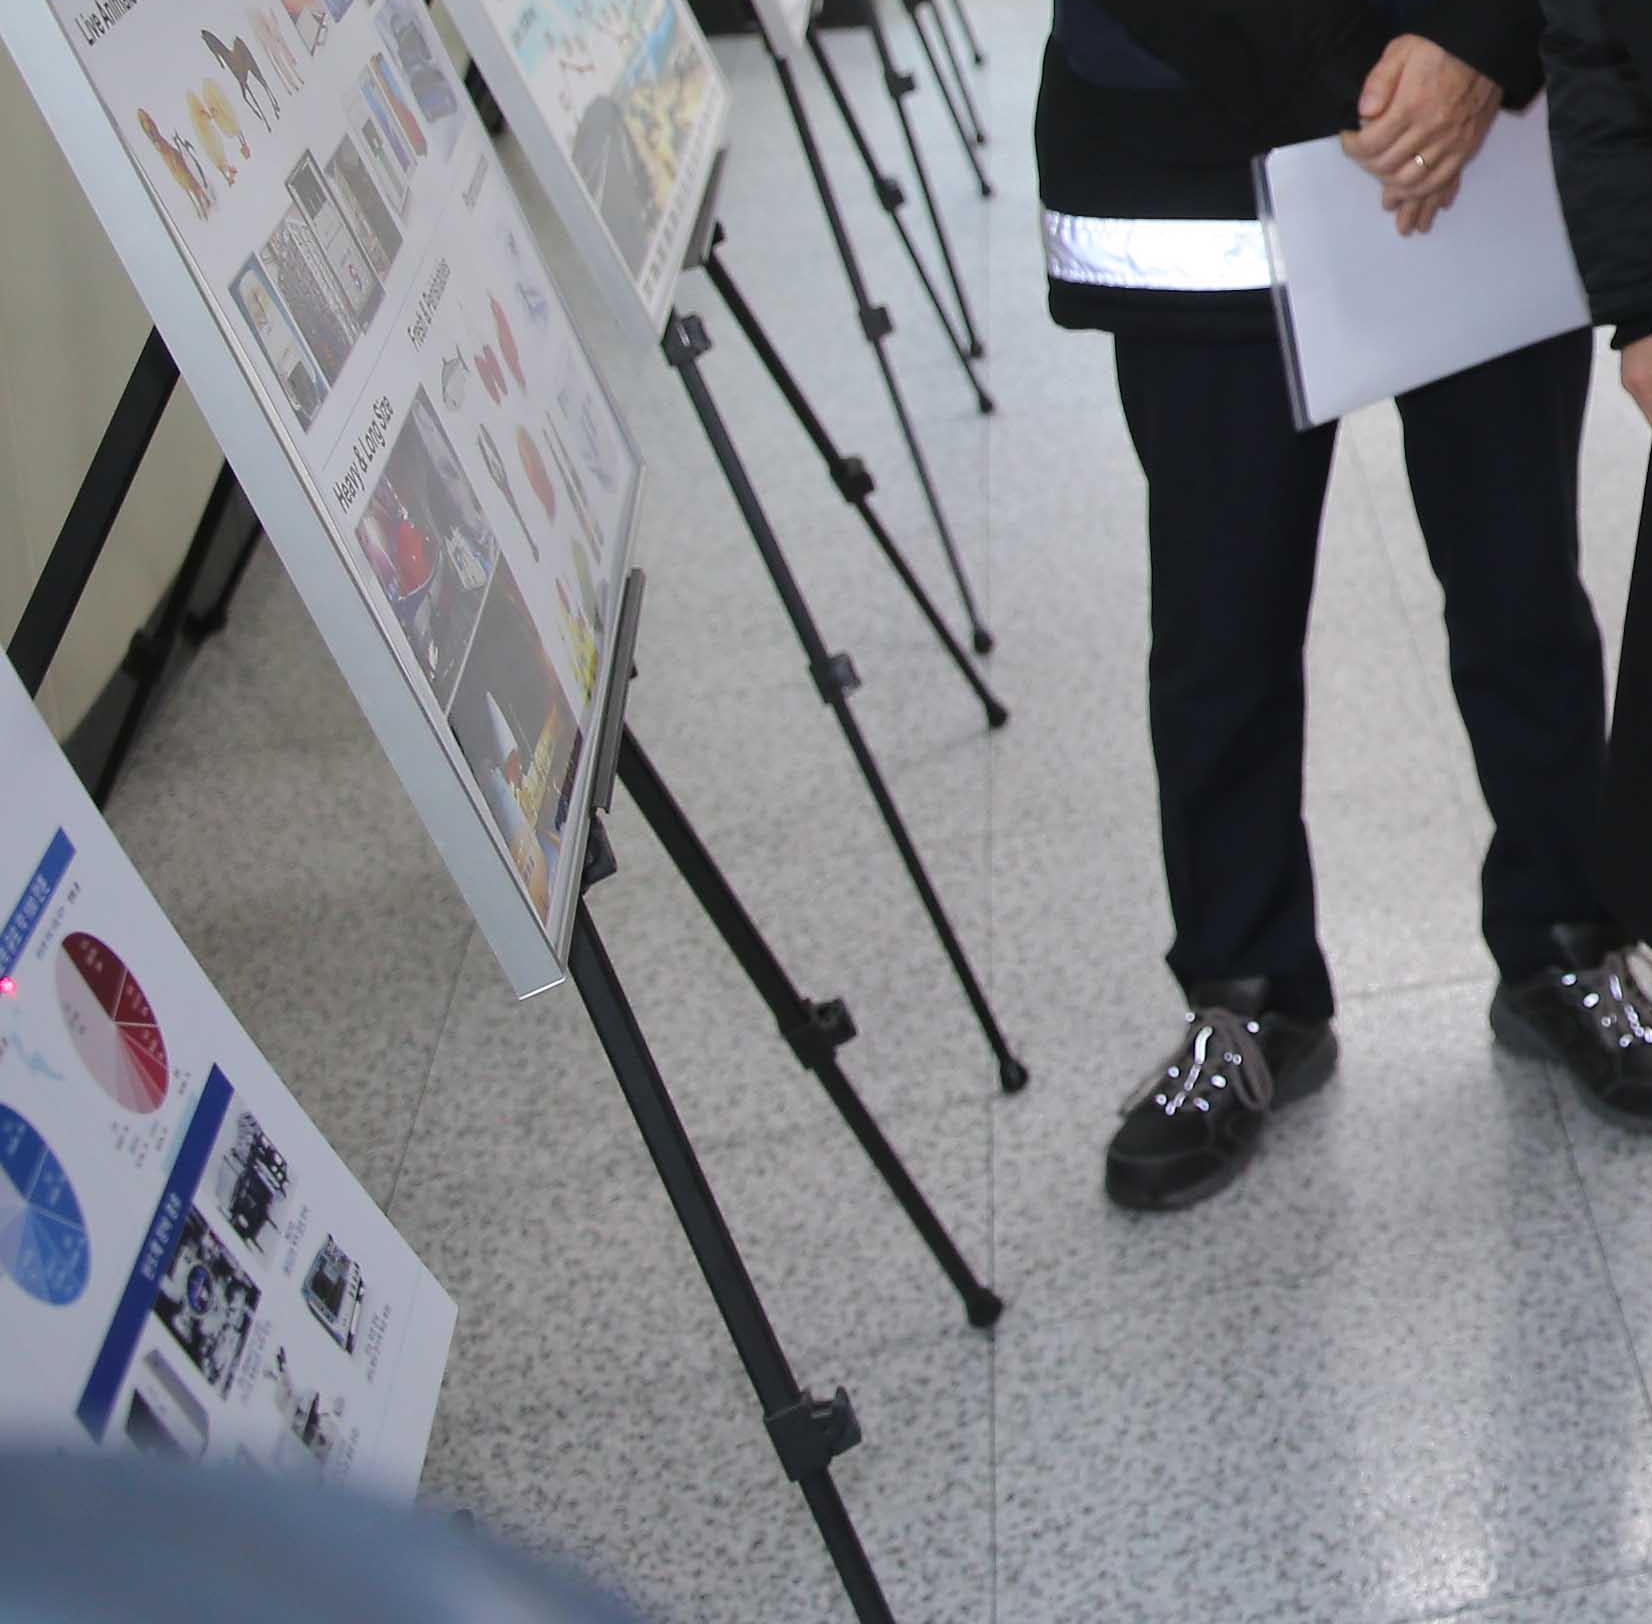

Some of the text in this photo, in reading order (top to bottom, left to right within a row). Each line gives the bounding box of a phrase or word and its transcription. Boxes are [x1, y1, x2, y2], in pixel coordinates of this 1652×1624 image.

[75, 7, 106, 47] Live
[332, 394, 395, 514] Heavy & Long Size
